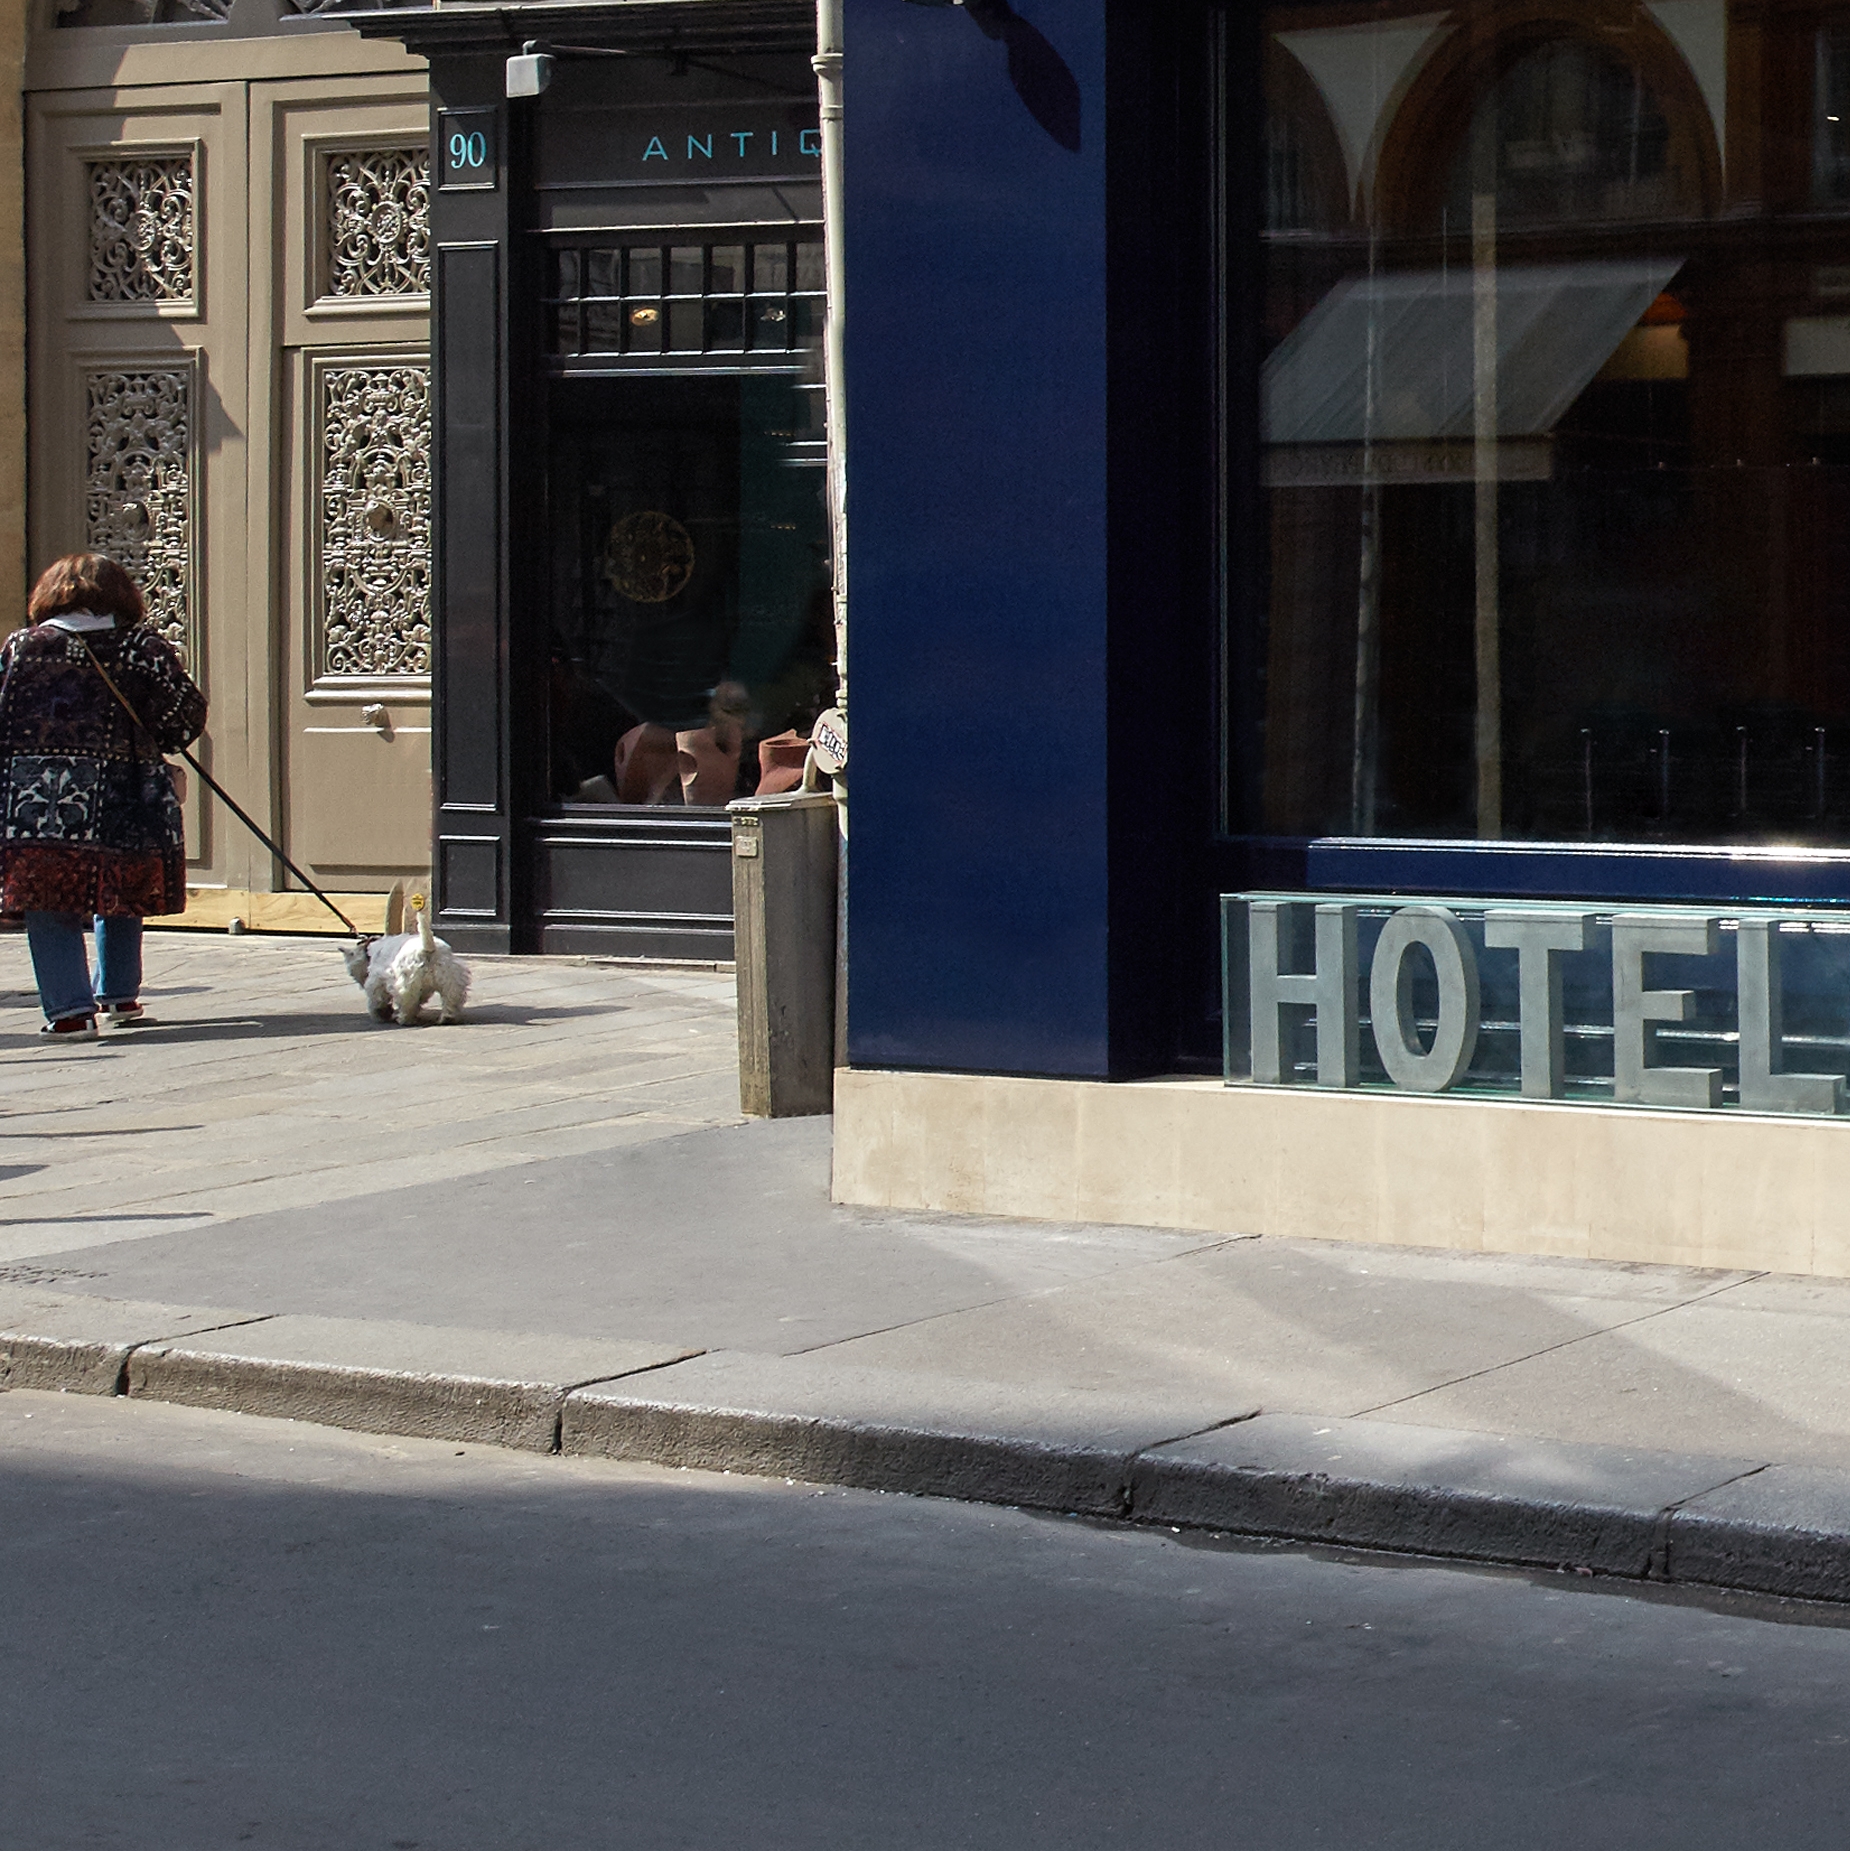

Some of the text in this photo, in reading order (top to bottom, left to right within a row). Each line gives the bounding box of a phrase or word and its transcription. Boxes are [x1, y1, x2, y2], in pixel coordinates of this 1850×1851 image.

[449, 131, 487, 169] 90
[642, 128, 821, 162] ANTIQ
[1248, 901, 1847, 1116] HOTEL
